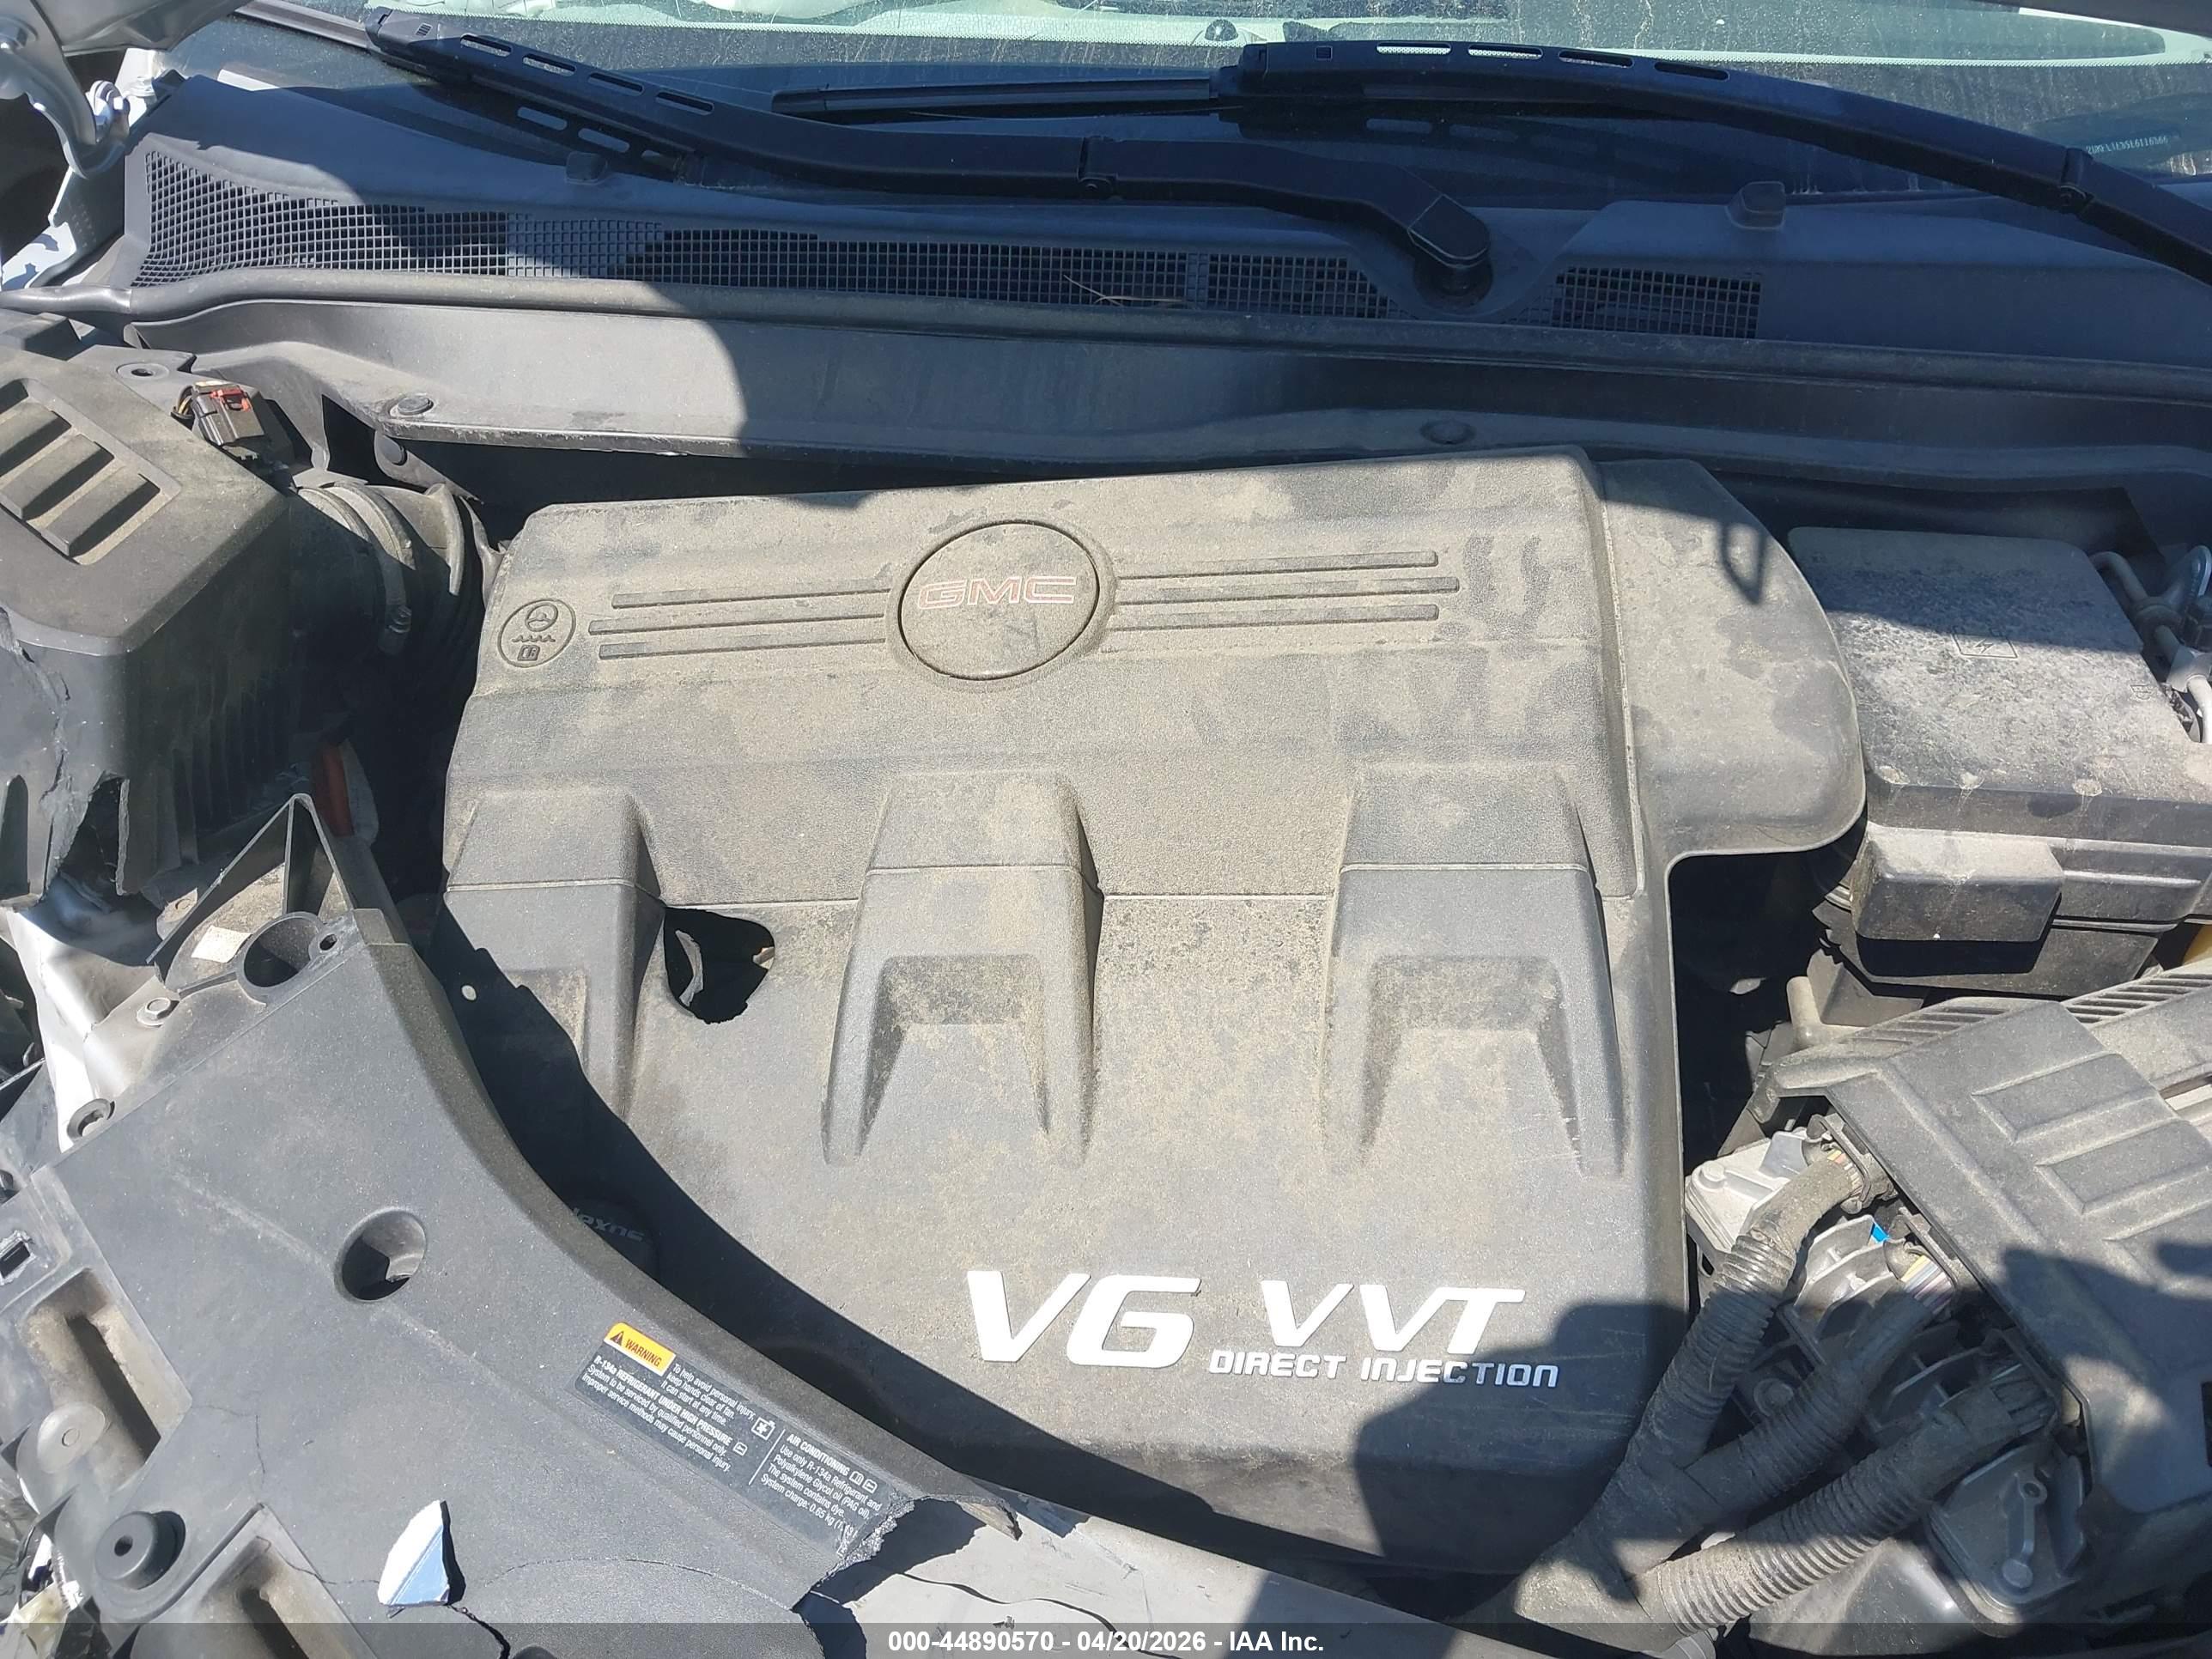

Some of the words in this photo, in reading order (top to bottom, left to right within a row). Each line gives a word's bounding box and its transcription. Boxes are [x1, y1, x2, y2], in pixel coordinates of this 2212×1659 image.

[918, 576, 1077, 610] GMC
[967, 1270, 1202, 1369] V6
[1261, 1279, 1527, 1355] VVT
[625, 1339, 661, 1366] WARNING
[1209, 1350, 1347, 1379] DIRECT
[1360, 1357, 1559, 1388] INJECTION
[586, 1364, 610, 1382] System
[623, 1388, 650, 1407] serviced
[657, 1408, 684, 1428] qualified
[681, 1425, 714, 1446] personnel
[593, 1355, 617, 1374] R-134a
[616, 1369, 659, 1399] REFRIGERANT
[658, 1395, 681, 1414] UNDER
[680, 1408, 698, 1424] HIGH
[696, 1419, 732, 1445] PRESSURE
[665, 1371, 682, 1386] keep
[681, 1381, 701, 1397] hands
[700, 1394, 716, 1407] clear
[722, 1406, 734, 1419] fan.
[678, 1391, 693, 1404] start
[699, 1405, 712, 1417] any
[711, 1411, 726, 1425] time.
[679, 1368, 694, 1382] help
[693, 1377, 712, 1392] avoid
[708, 1388, 738, 1407] personal
[581, 1373, 608, 1393] Improper
[607, 1390, 629, 1407] service
[629, 1403, 654, 1423] methods
[653, 1419, 668, 1432] may
[667, 1428, 686, 1443] cause
[684, 1439, 713, 1459] personal
[711, 1455, 731, 1471] injury.
[780, 1444, 793, 1457] Use
[792, 1454, 807, 1467] only
[806, 1460, 831, 1481] R-134a
[830, 1475, 868, 1504] Refrigerant
[786, 1433, 800, 1446] AIR
[799, 1441, 849, 1475] CONDITIONING
[761, 1474, 785, 1492] System
[784, 1489, 810, 1509] charge:
[809, 1504, 826, 1518] 0.65
[768, 1462, 781, 1477] The
[779, 1473, 803, 1491] system
[803, 1487, 831, 1508] contains
[830, 1504, 844, 1517] dye.
[773, 1454, 812, 1483] Polyalkylene
[812, 1478, 834, 1495] Glycol
[841, 1496, 859, 1511] (PAG
[857, 1507, 869, 1519] oil).
